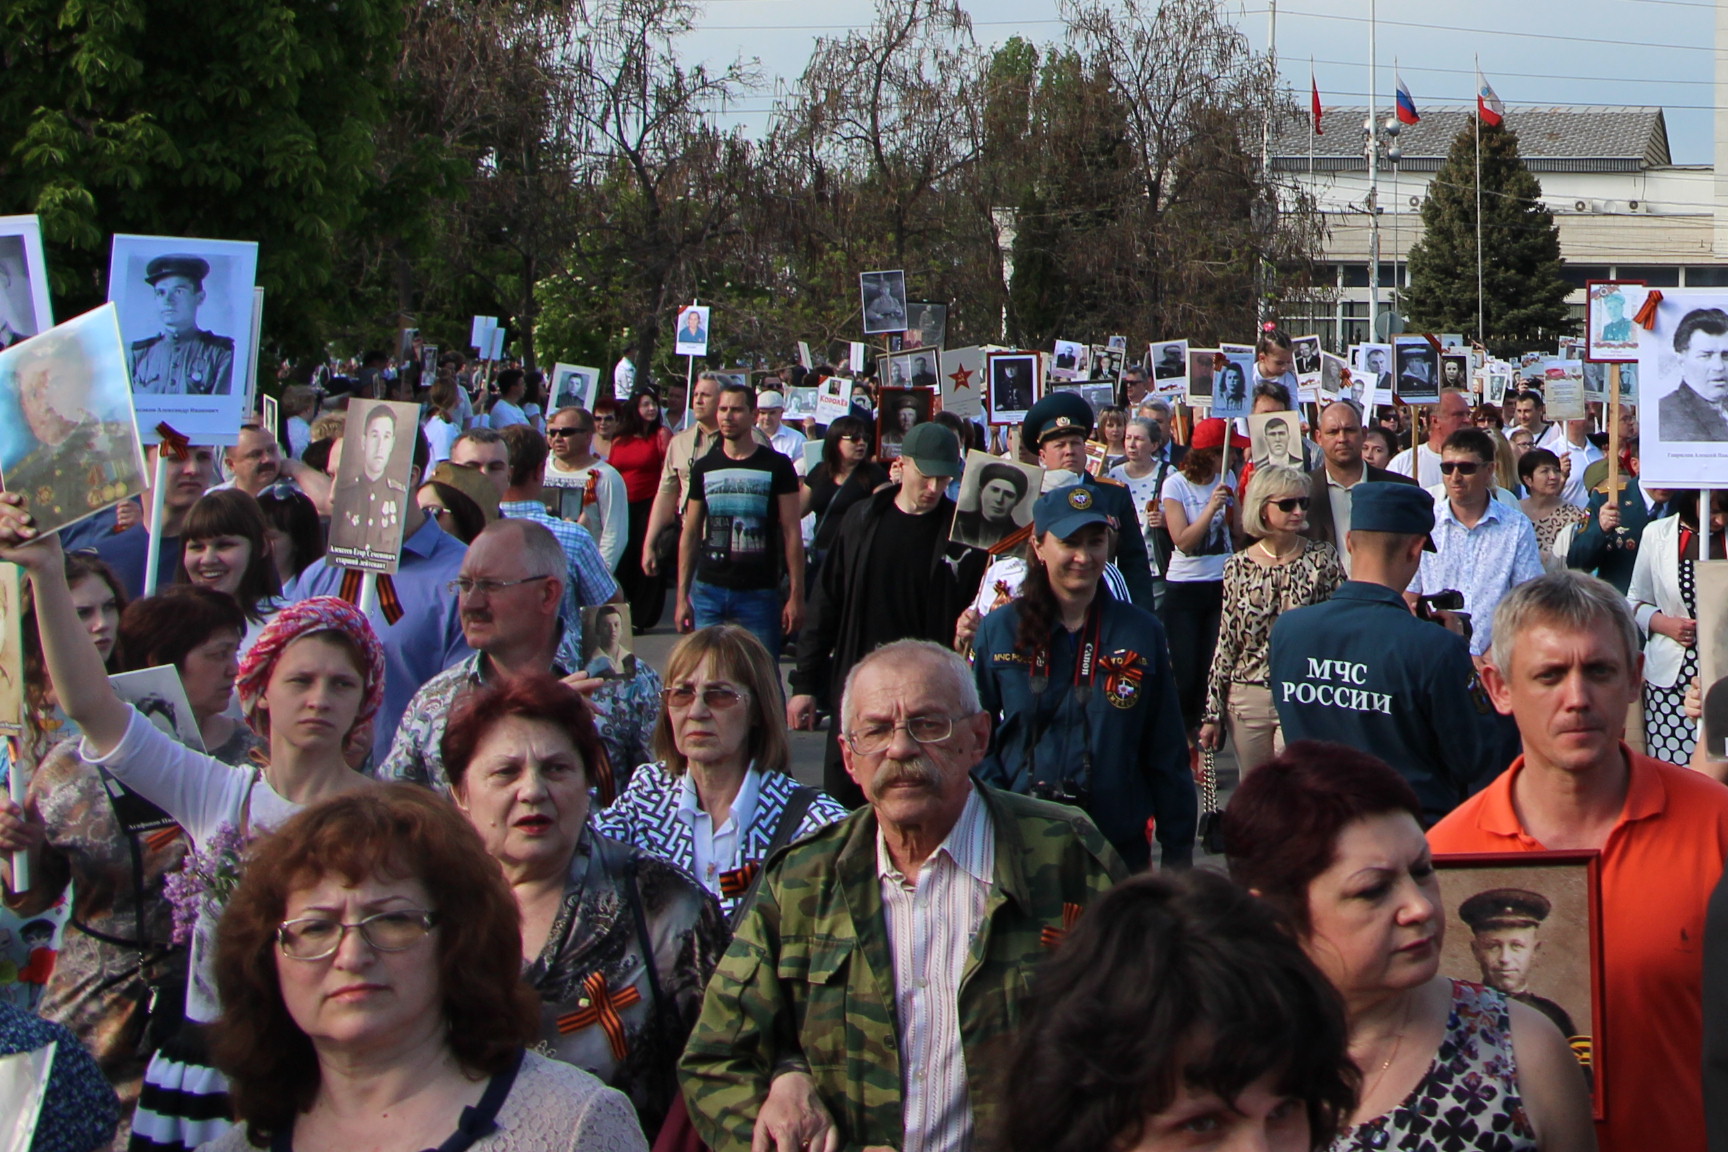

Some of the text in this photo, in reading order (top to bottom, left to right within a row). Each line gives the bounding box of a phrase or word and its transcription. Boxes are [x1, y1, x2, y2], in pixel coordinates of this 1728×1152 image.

[1012, 653, 1034, 665] РОСС
[1081, 642, 1094, 676] Canon
[1306, 657, 1368, 685] МЧС
[1281, 681, 1392, 716] РОССИИ
